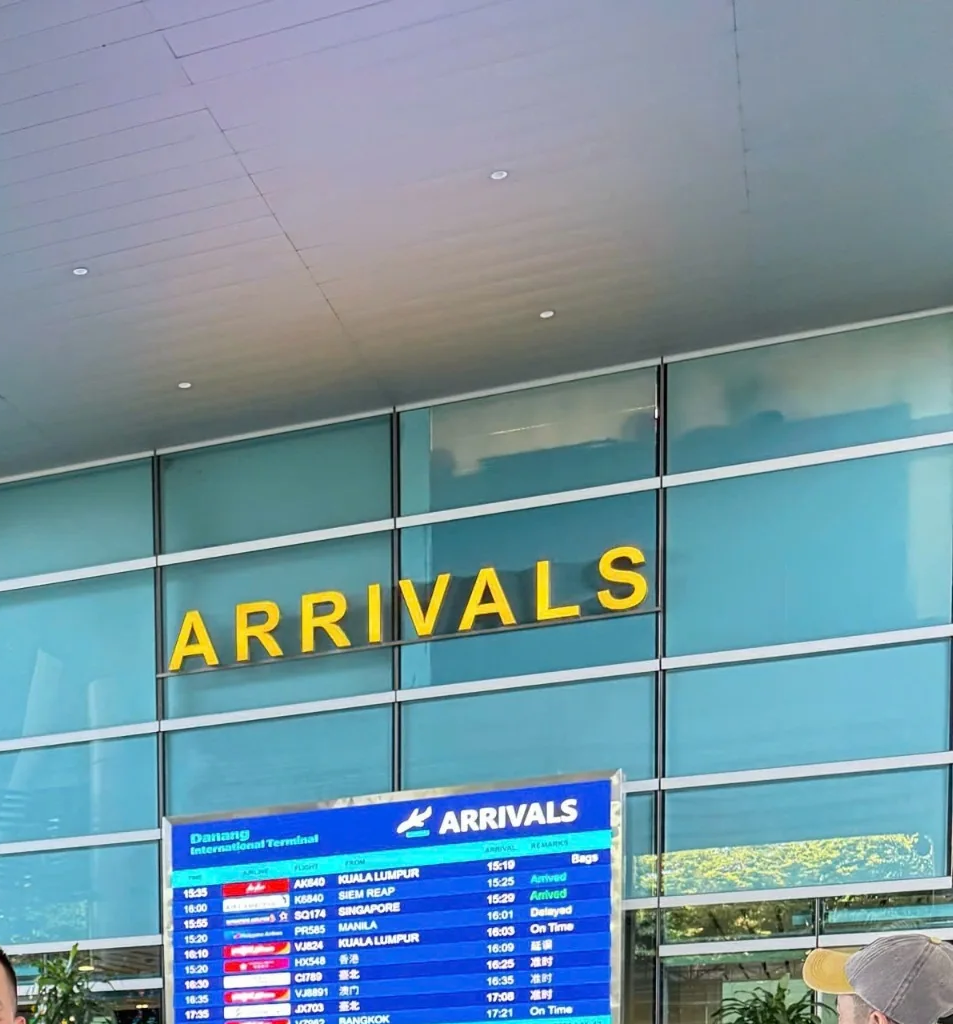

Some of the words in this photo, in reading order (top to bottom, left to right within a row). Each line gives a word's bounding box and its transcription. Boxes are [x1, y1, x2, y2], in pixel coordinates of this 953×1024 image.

[168, 546, 648, 671] ARRIVALS
[439, 798, 578, 834] ARRIVALS
[190, 829, 250, 845] Danang
[190, 839, 265, 855] International
[266, 834, 319, 848] Terminal
[294, 863, 318, 871] FLIGHT
[485, 845, 518, 853] ARRIVAL
[530, 840, 569, 849] REMARKS
[338, 872, 374, 885] KUALA
[374, 868, 420, 881] LUMPUR
[571, 854, 599, 865] Bags
[338, 889, 364, 900] SIEM
[366, 886, 396, 898] REAP
[487, 876, 515, 888] 15:25
[530, 872, 567, 884] Arrived
[294, 909, 326, 920] SQ174
[338, 902, 401, 916] SINGAPORE
[487, 893, 515, 904] 15:29
[530, 888, 568, 901] Arrived
[184, 933, 208, 944] 15:20
[294, 925, 326, 936] PR585
[338, 920, 378, 932] MANILA
[487, 910, 514, 921] 16:01
[530, 905, 573, 918] Delayed
[338, 937, 374, 949] KUALA
[374, 933, 420, 946] LUMPUR
[487, 926, 515, 937] 16:03
[530, 923, 547, 934] On
[548, 921, 575, 933] Time
[185, 964, 209, 975] 15:20
[294, 956, 326, 967] HX548
[487, 943, 515, 953] 16:09
[486, 959, 515, 970] 16:25
[486, 975, 515, 986] 16:35
[294, 1003, 325, 1014] JX703
[486, 1008, 513, 1019] 17:21
[530, 1006, 546, 1016] On
[548, 1005, 574, 1015] Time
